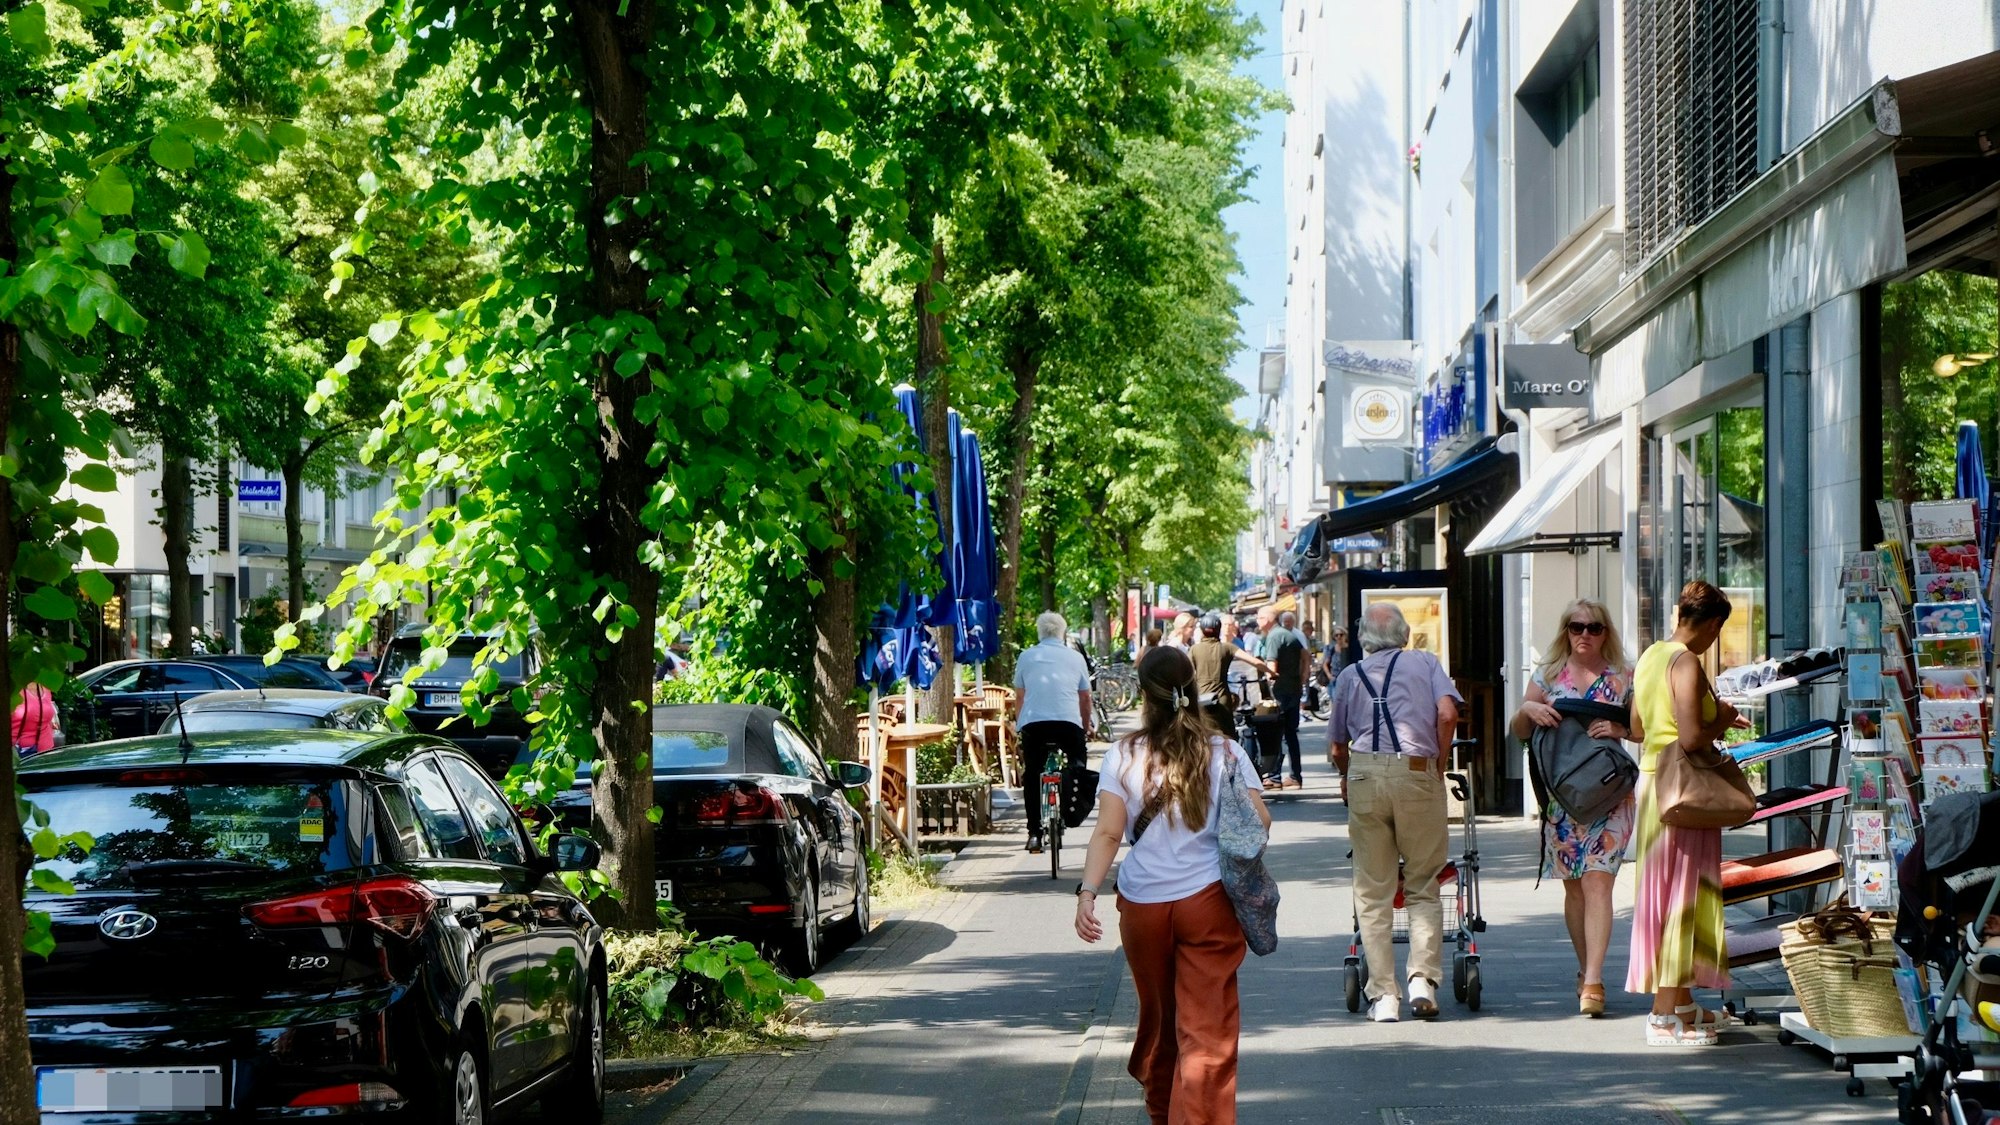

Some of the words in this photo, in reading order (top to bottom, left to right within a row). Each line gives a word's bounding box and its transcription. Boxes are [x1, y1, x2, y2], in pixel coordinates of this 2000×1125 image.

[1512, 380, 1562, 394] Marc
[434, 693, 446, 704] BM
[288, 955, 330, 970] i20
